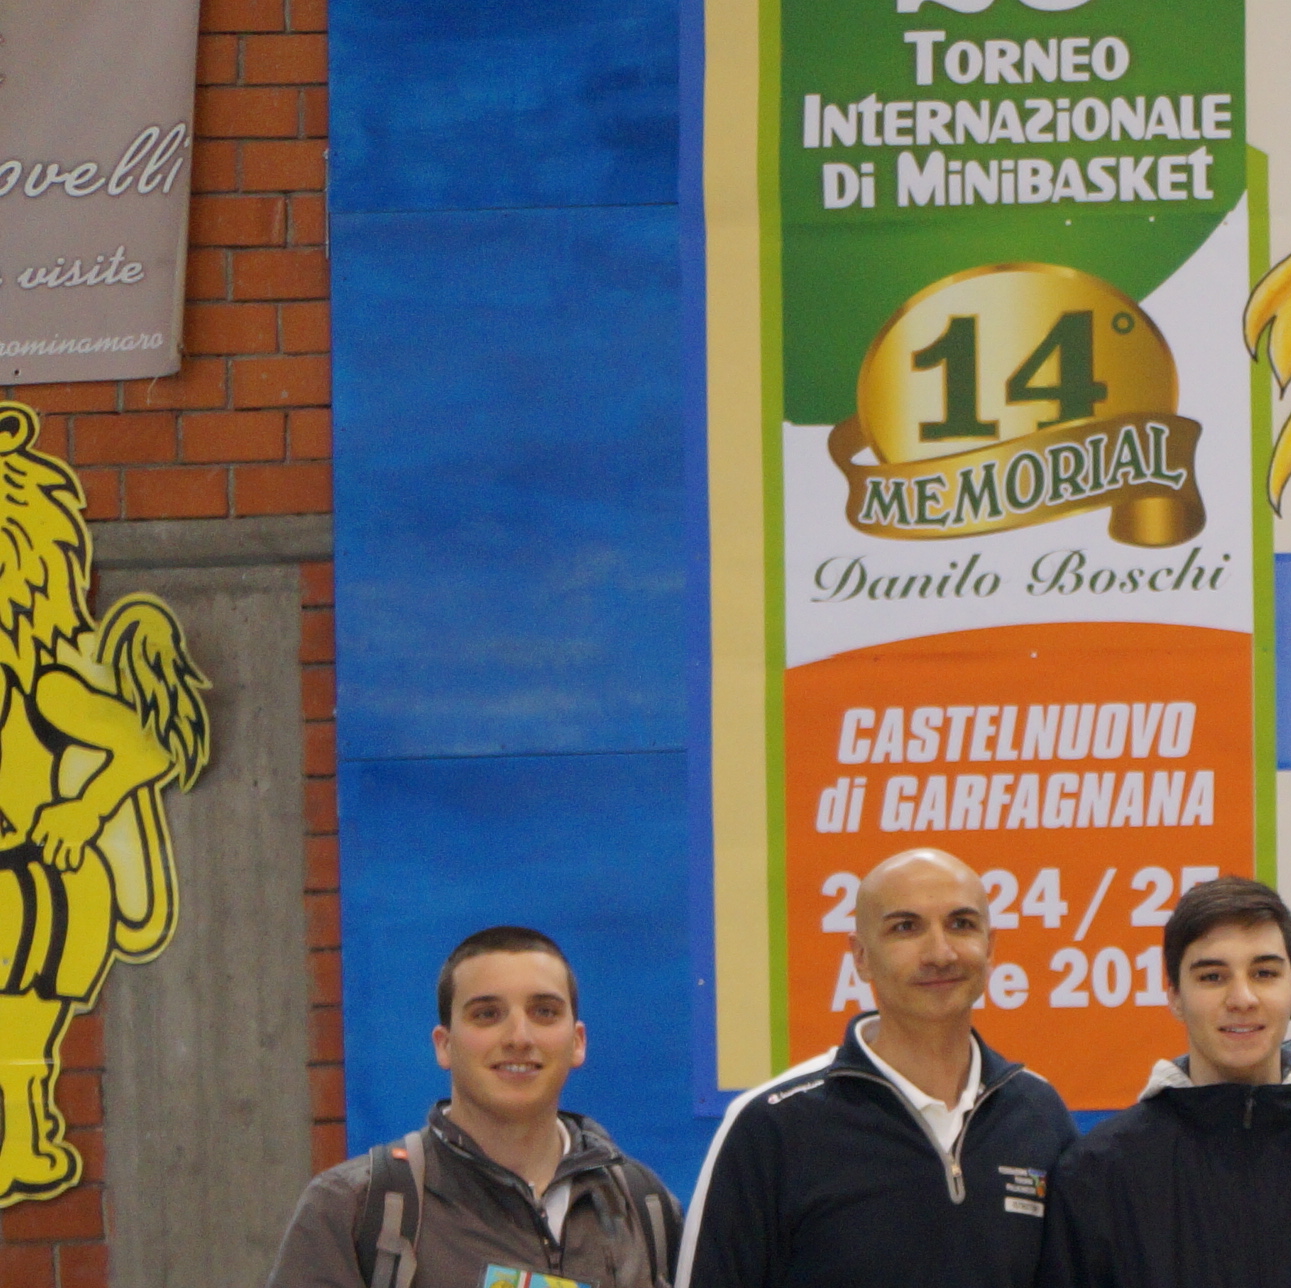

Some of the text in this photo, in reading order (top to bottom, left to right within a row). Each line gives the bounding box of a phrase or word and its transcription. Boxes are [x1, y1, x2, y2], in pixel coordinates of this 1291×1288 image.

[17, 245, 144, 289] visite
[0, 330, 163, 358] ominamaro
[858, 422, 1184, 529] MEMORIAL
[810, 546, 1232, 603] Danilo Boschi
[837, 702, 1197, 764] CASTELNUOVO
[815, 770, 1216, 834] di GARFAGNANA
